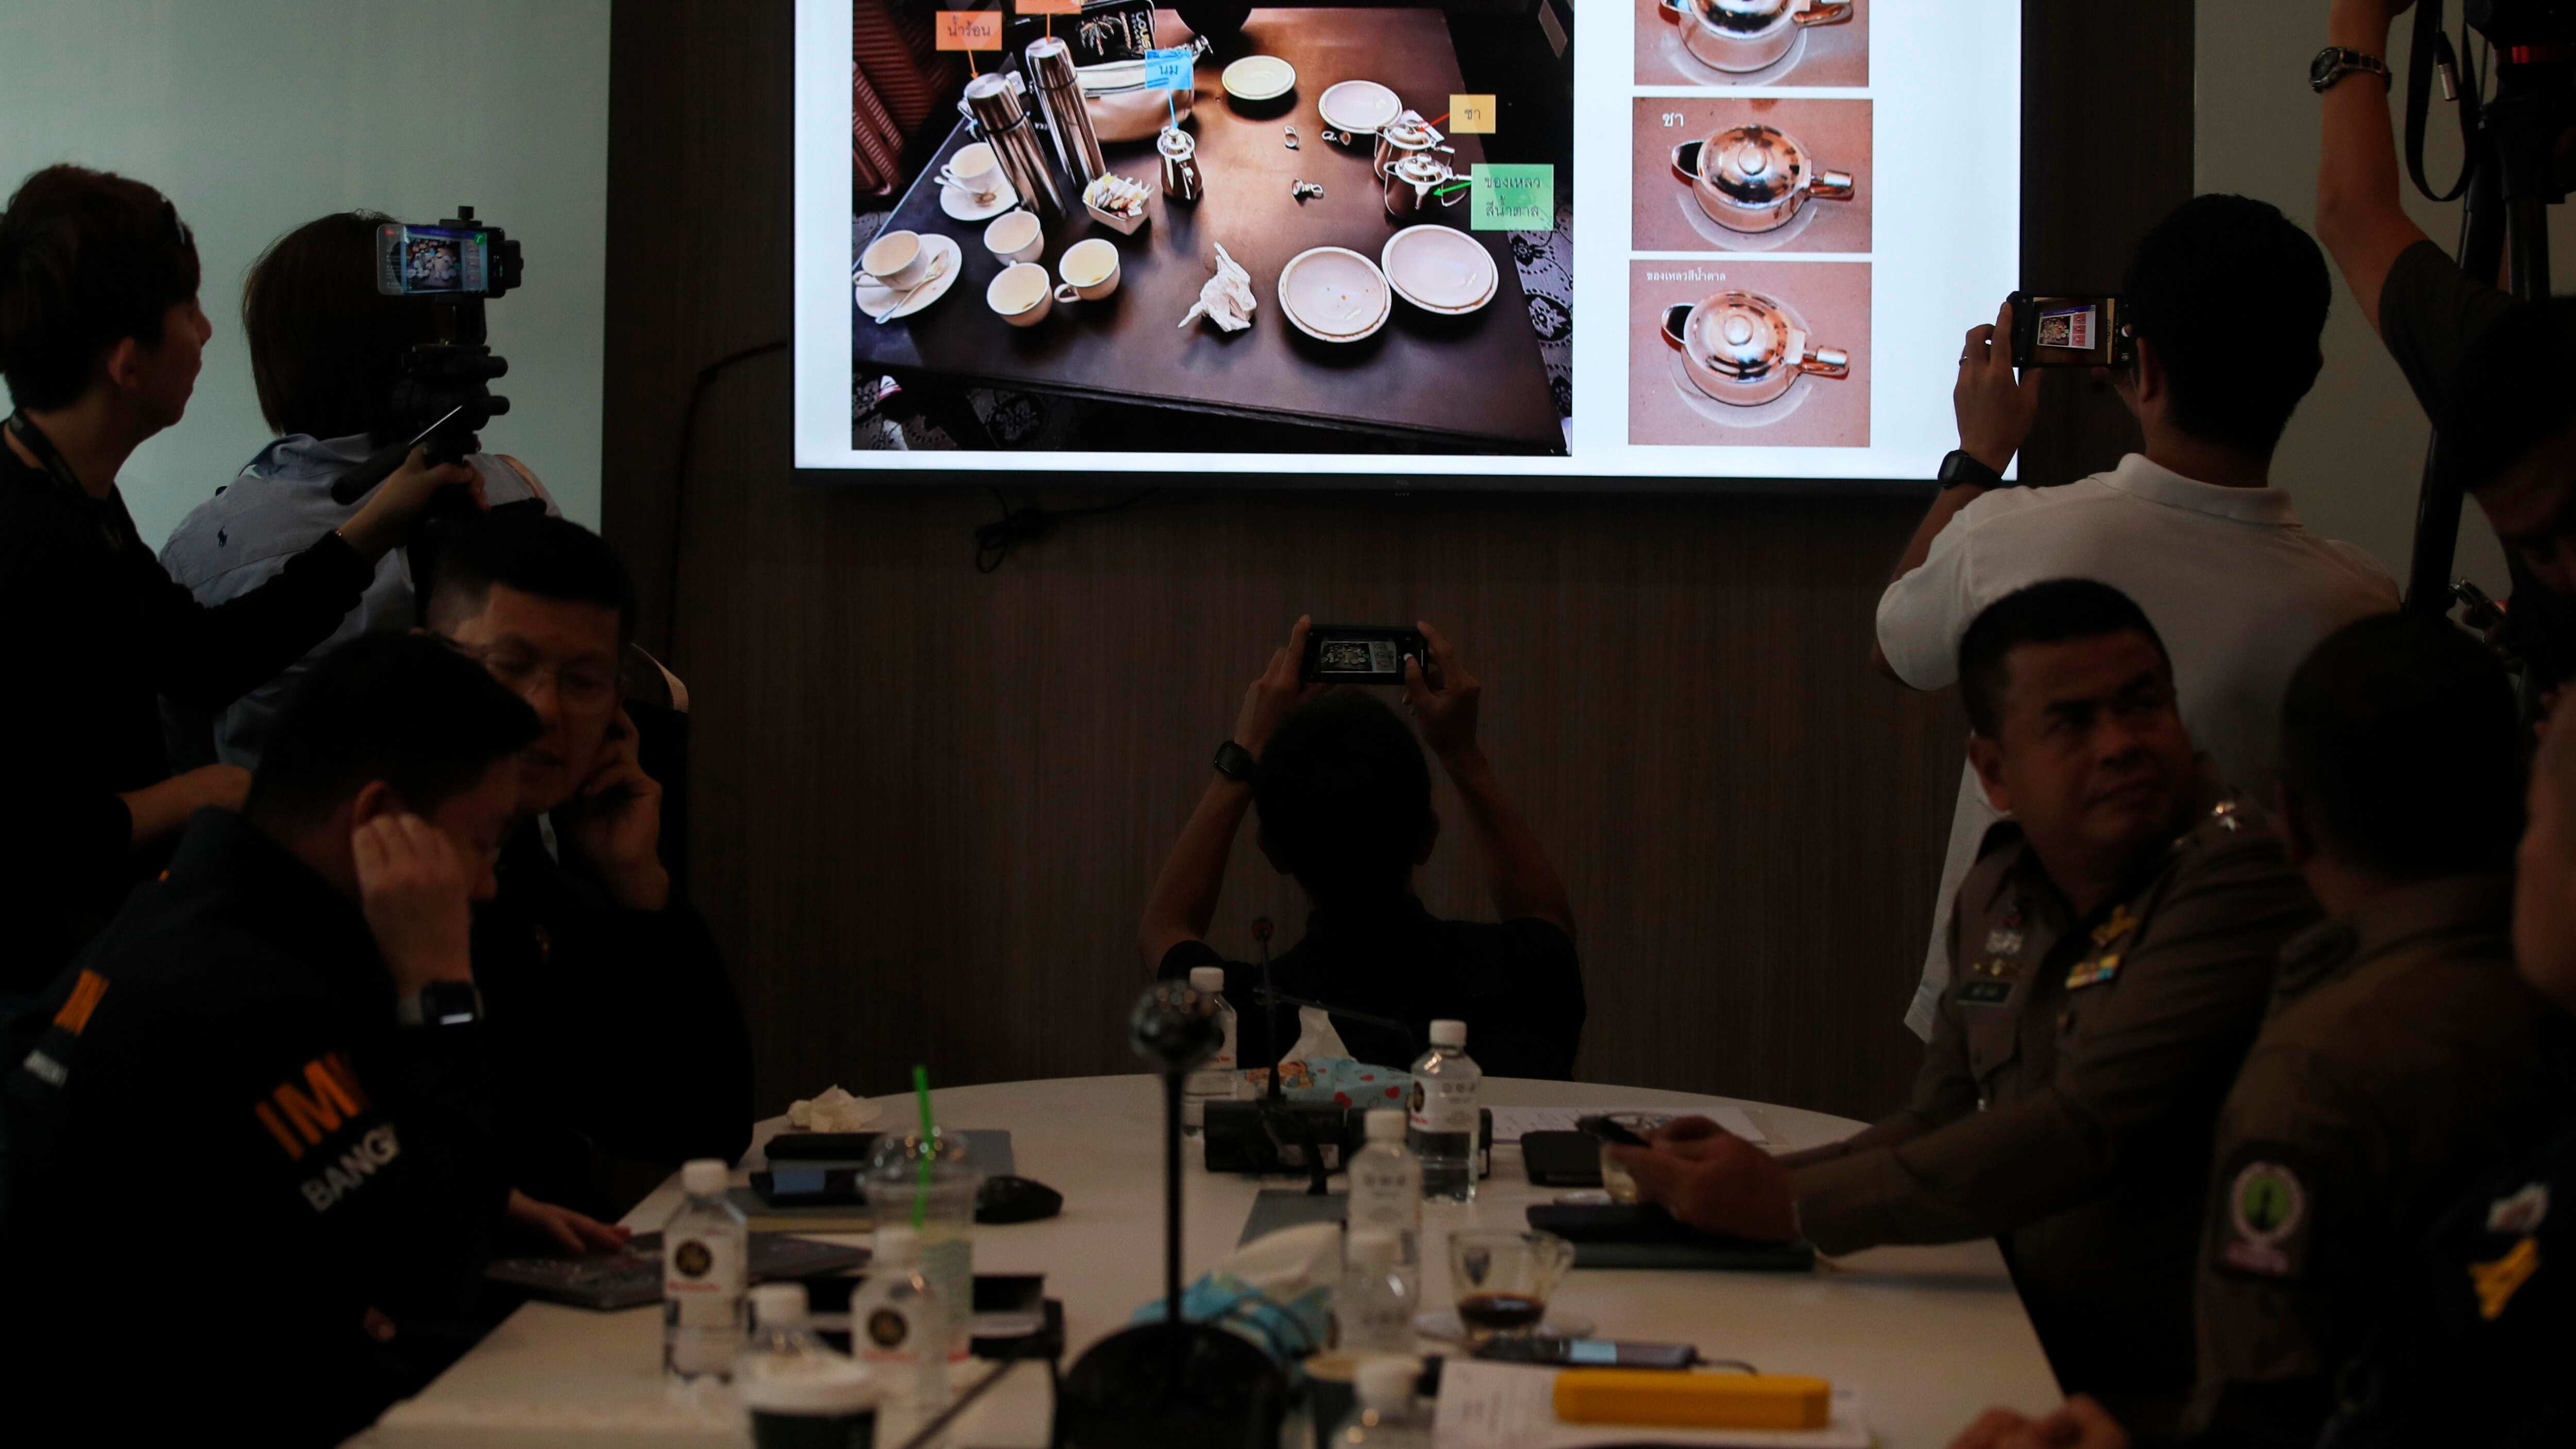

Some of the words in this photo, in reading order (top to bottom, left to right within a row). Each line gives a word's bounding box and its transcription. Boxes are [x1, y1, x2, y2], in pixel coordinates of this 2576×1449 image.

[947, 14, 991, 37] น้ำร้อน
[1662, 112, 1684, 128] ชา
[1484, 177, 1540, 189] ของเหลว
[1485, 194, 1539, 217] สีน้ำตาล
[1646, 266, 1726, 281] ของเหลวสีน้ำตาล
